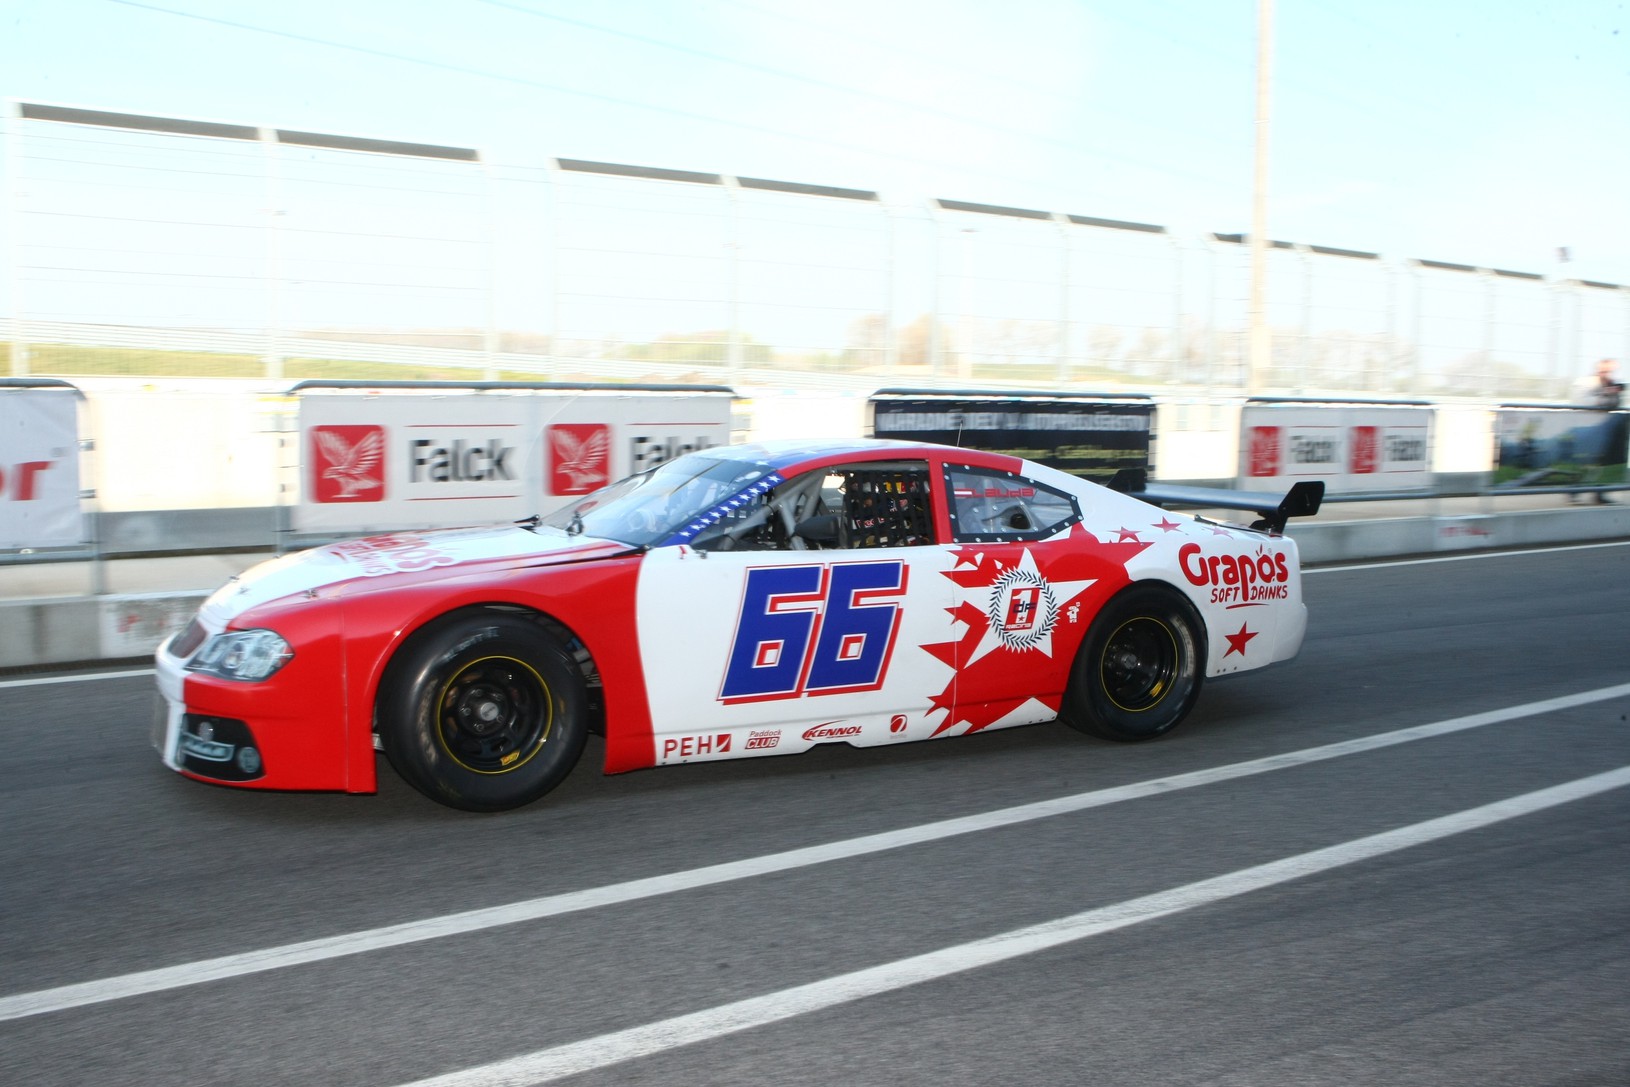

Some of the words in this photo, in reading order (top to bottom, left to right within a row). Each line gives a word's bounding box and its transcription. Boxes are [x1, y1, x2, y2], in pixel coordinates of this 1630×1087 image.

[409, 438, 517, 483] Falck
[1210, 586, 1240, 604] SOFT
[1250, 585, 1288, 601] DRINKS
[716, 559, 910, 706] 66
[807, 725, 862, 739] KENNOL
[663, 735, 712, 759] PEH
[746, 738, 778, 750] CLUB
